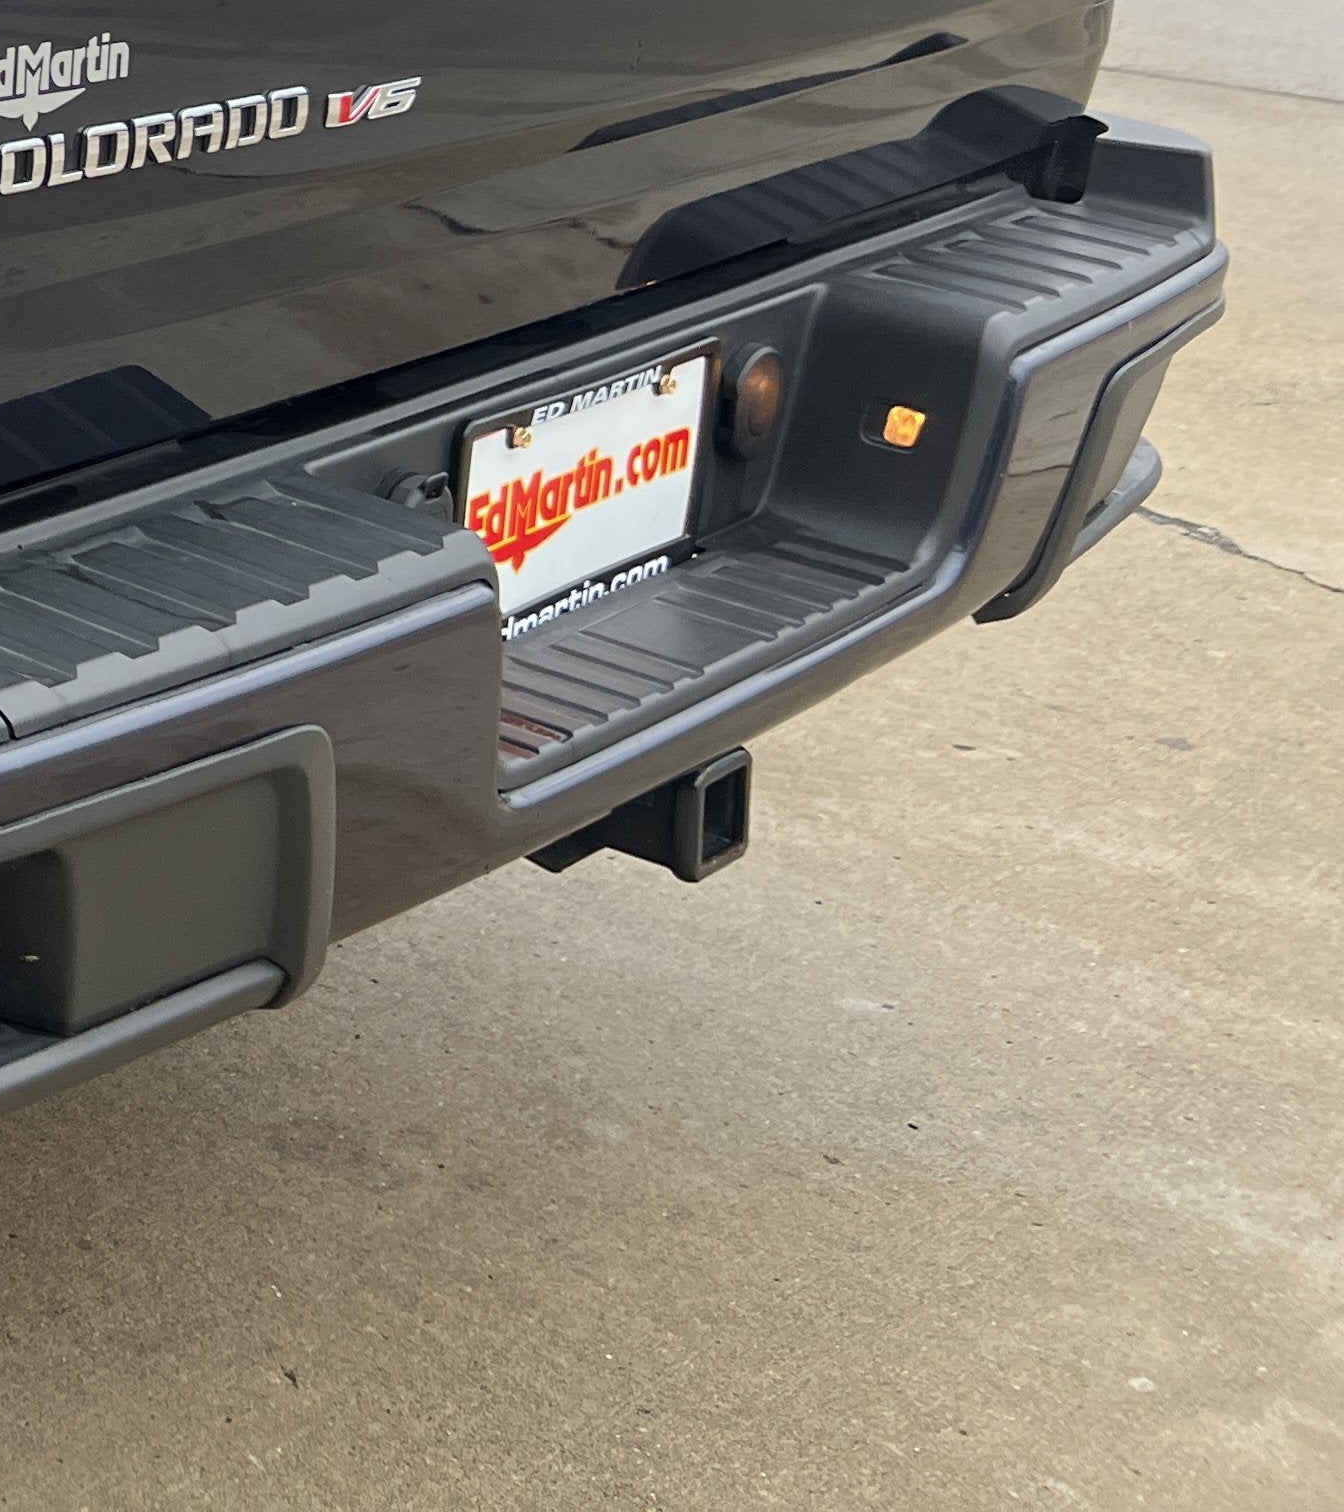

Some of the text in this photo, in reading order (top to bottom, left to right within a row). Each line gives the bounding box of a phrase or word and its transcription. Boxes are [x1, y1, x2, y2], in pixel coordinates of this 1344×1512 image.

[325, 76, 422, 129] V6
[531, 365, 662, 426] ED MARTIN
[467, 426, 692, 540] EdMartin.com
[501, 554, 670, 640] dmartin.com
